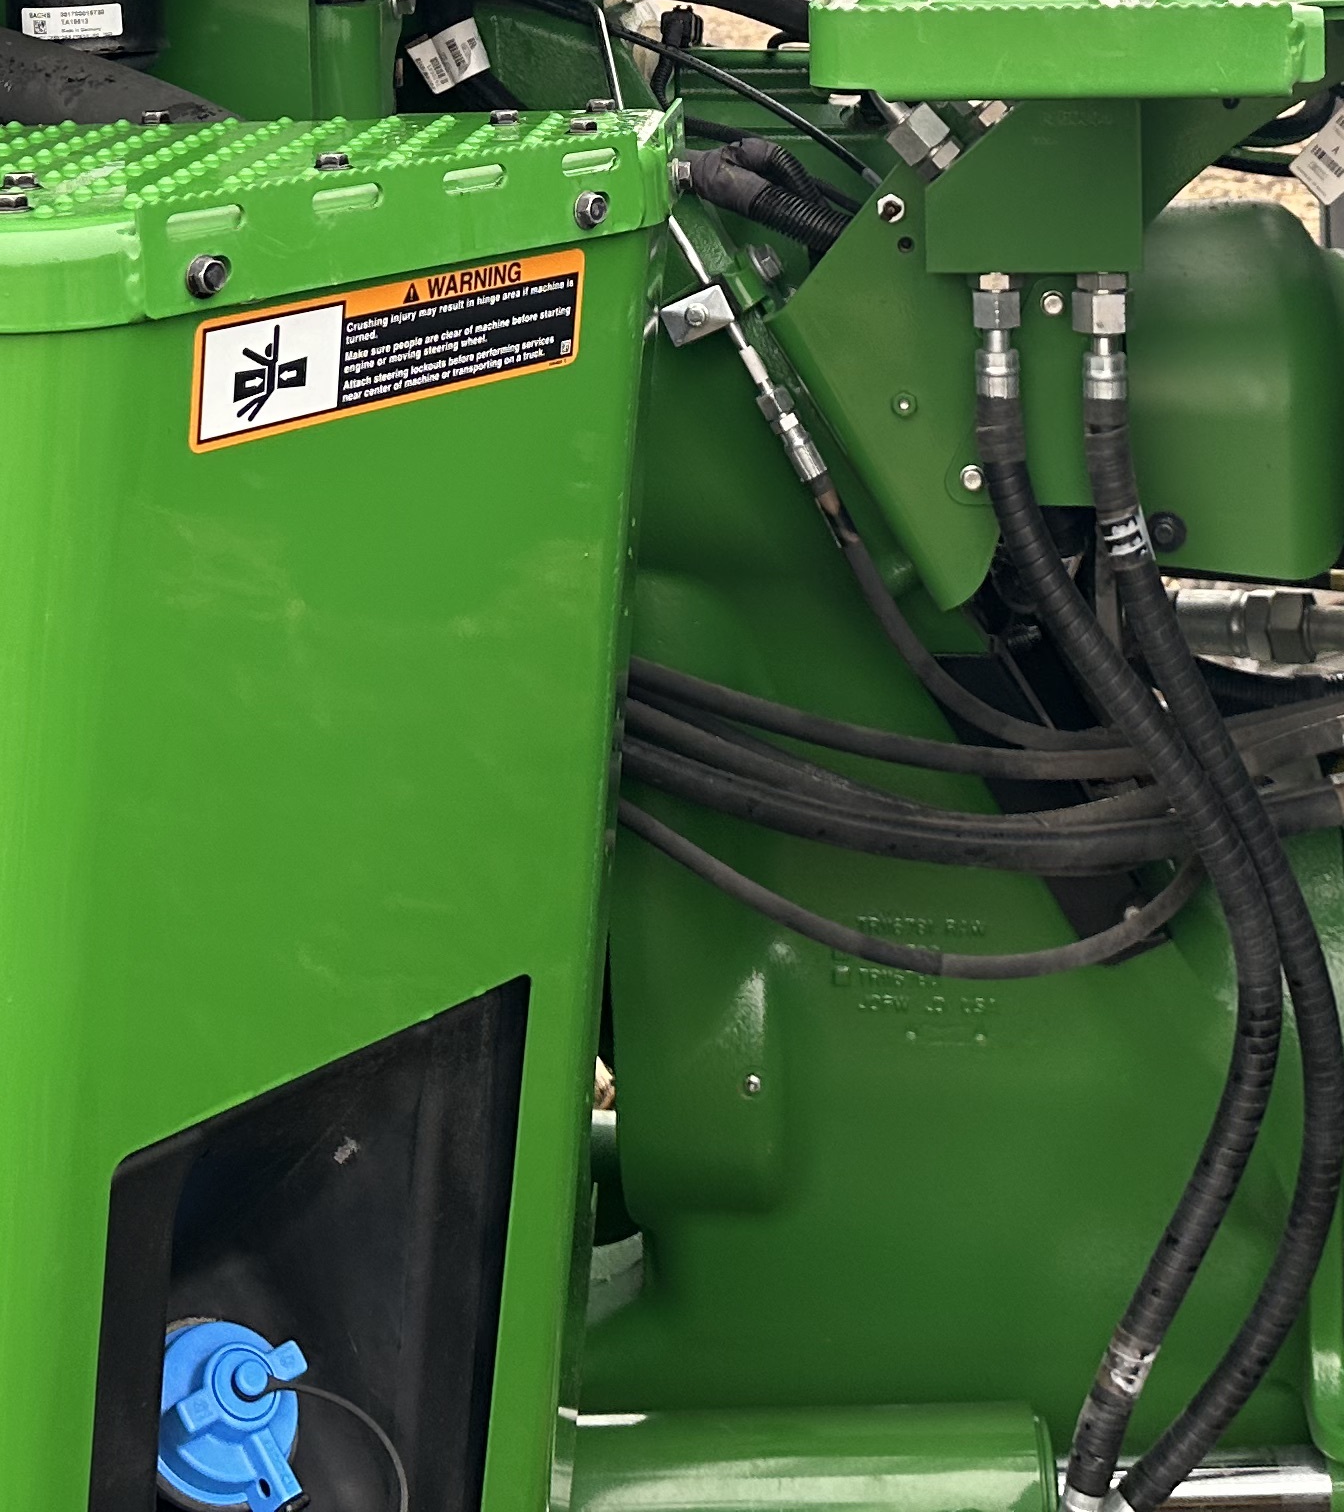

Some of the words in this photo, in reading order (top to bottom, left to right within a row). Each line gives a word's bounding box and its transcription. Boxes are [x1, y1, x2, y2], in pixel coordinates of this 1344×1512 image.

[346, 316, 389, 333] Crushing
[390, 311, 417, 324] injury
[418, 306, 437, 318] may
[439, 300, 465, 314] result
[466, 298, 475, 308] in
[476, 293, 501, 306] hinge
[502, 289, 521, 301] area
[522, 286, 530, 297] if
[530, 281, 565, 295] machine
[567, 278, 574, 288] is
[427, 262, 522, 299] WARNING
[343, 360, 375, 374] engine
[376, 357, 387, 367] or
[388, 348, 422, 364] moving
[423, 340, 459, 356] steering
[460, 333, 488, 348] wheel.
[344, 349, 369, 362] Make
[370, 344, 391, 356] sure
[392, 336, 423, 353] people
[424, 333, 439, 345] are
[440, 328, 462, 341] clear
[463, 325, 474, 336] of
[474, 318, 511, 333] machine
[511, 313, 538, 326] before
[539, 306, 572, 320] starting
[345, 330, 378, 345] turned.
[341, 390, 363, 403] near
[363, 382, 392, 398] center
[393, 379, 403, 391] of
[404, 373, 440, 388] machine
[441, 369, 452, 380] or
[452, 357, 503, 376] transporting
[503, 354, 515, 364] on
[516, 353, 522, 363] a
[523, 348, 546, 361] truck.
[343, 375, 372, 390] Attach
[373, 368, 409, 383] steering
[410, 360, 447, 375] lockouts
[447, 352, 475, 366] before
[476, 343, 521, 361] performing
[521, 335, 555, 350] services
